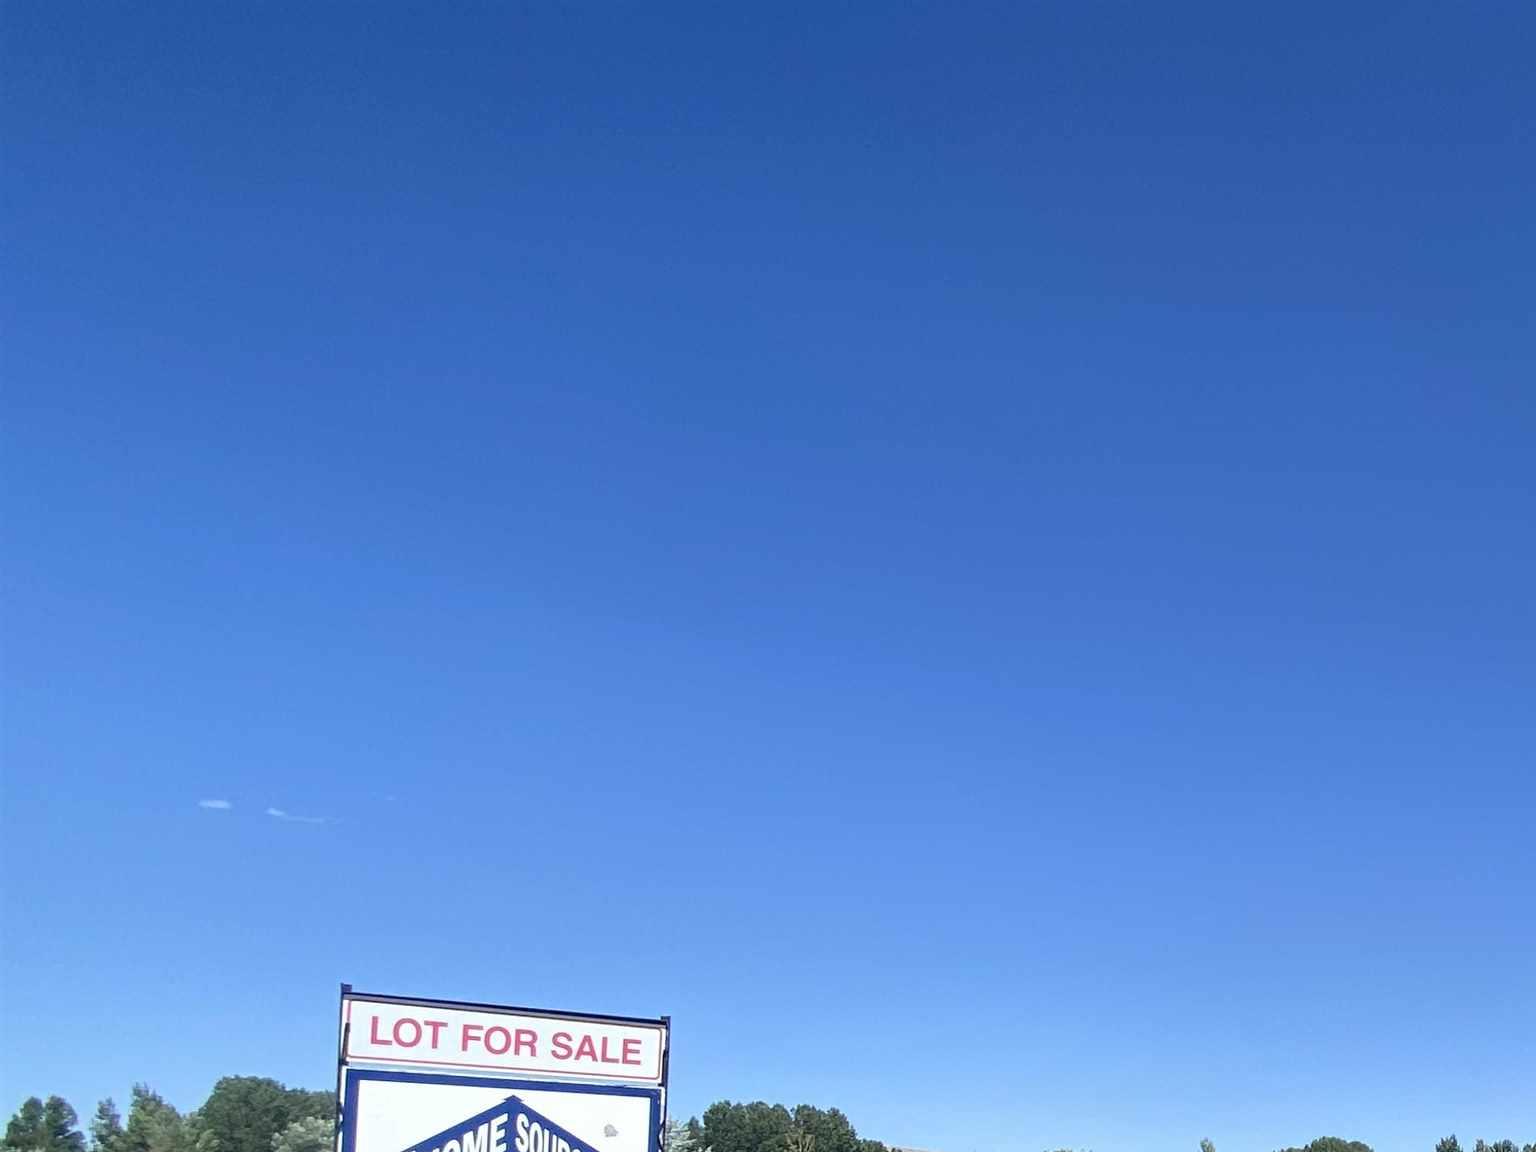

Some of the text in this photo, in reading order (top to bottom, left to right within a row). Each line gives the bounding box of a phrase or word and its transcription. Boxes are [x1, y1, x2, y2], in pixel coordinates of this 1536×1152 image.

[370, 1015, 642, 1066] LOT FOR SALE
